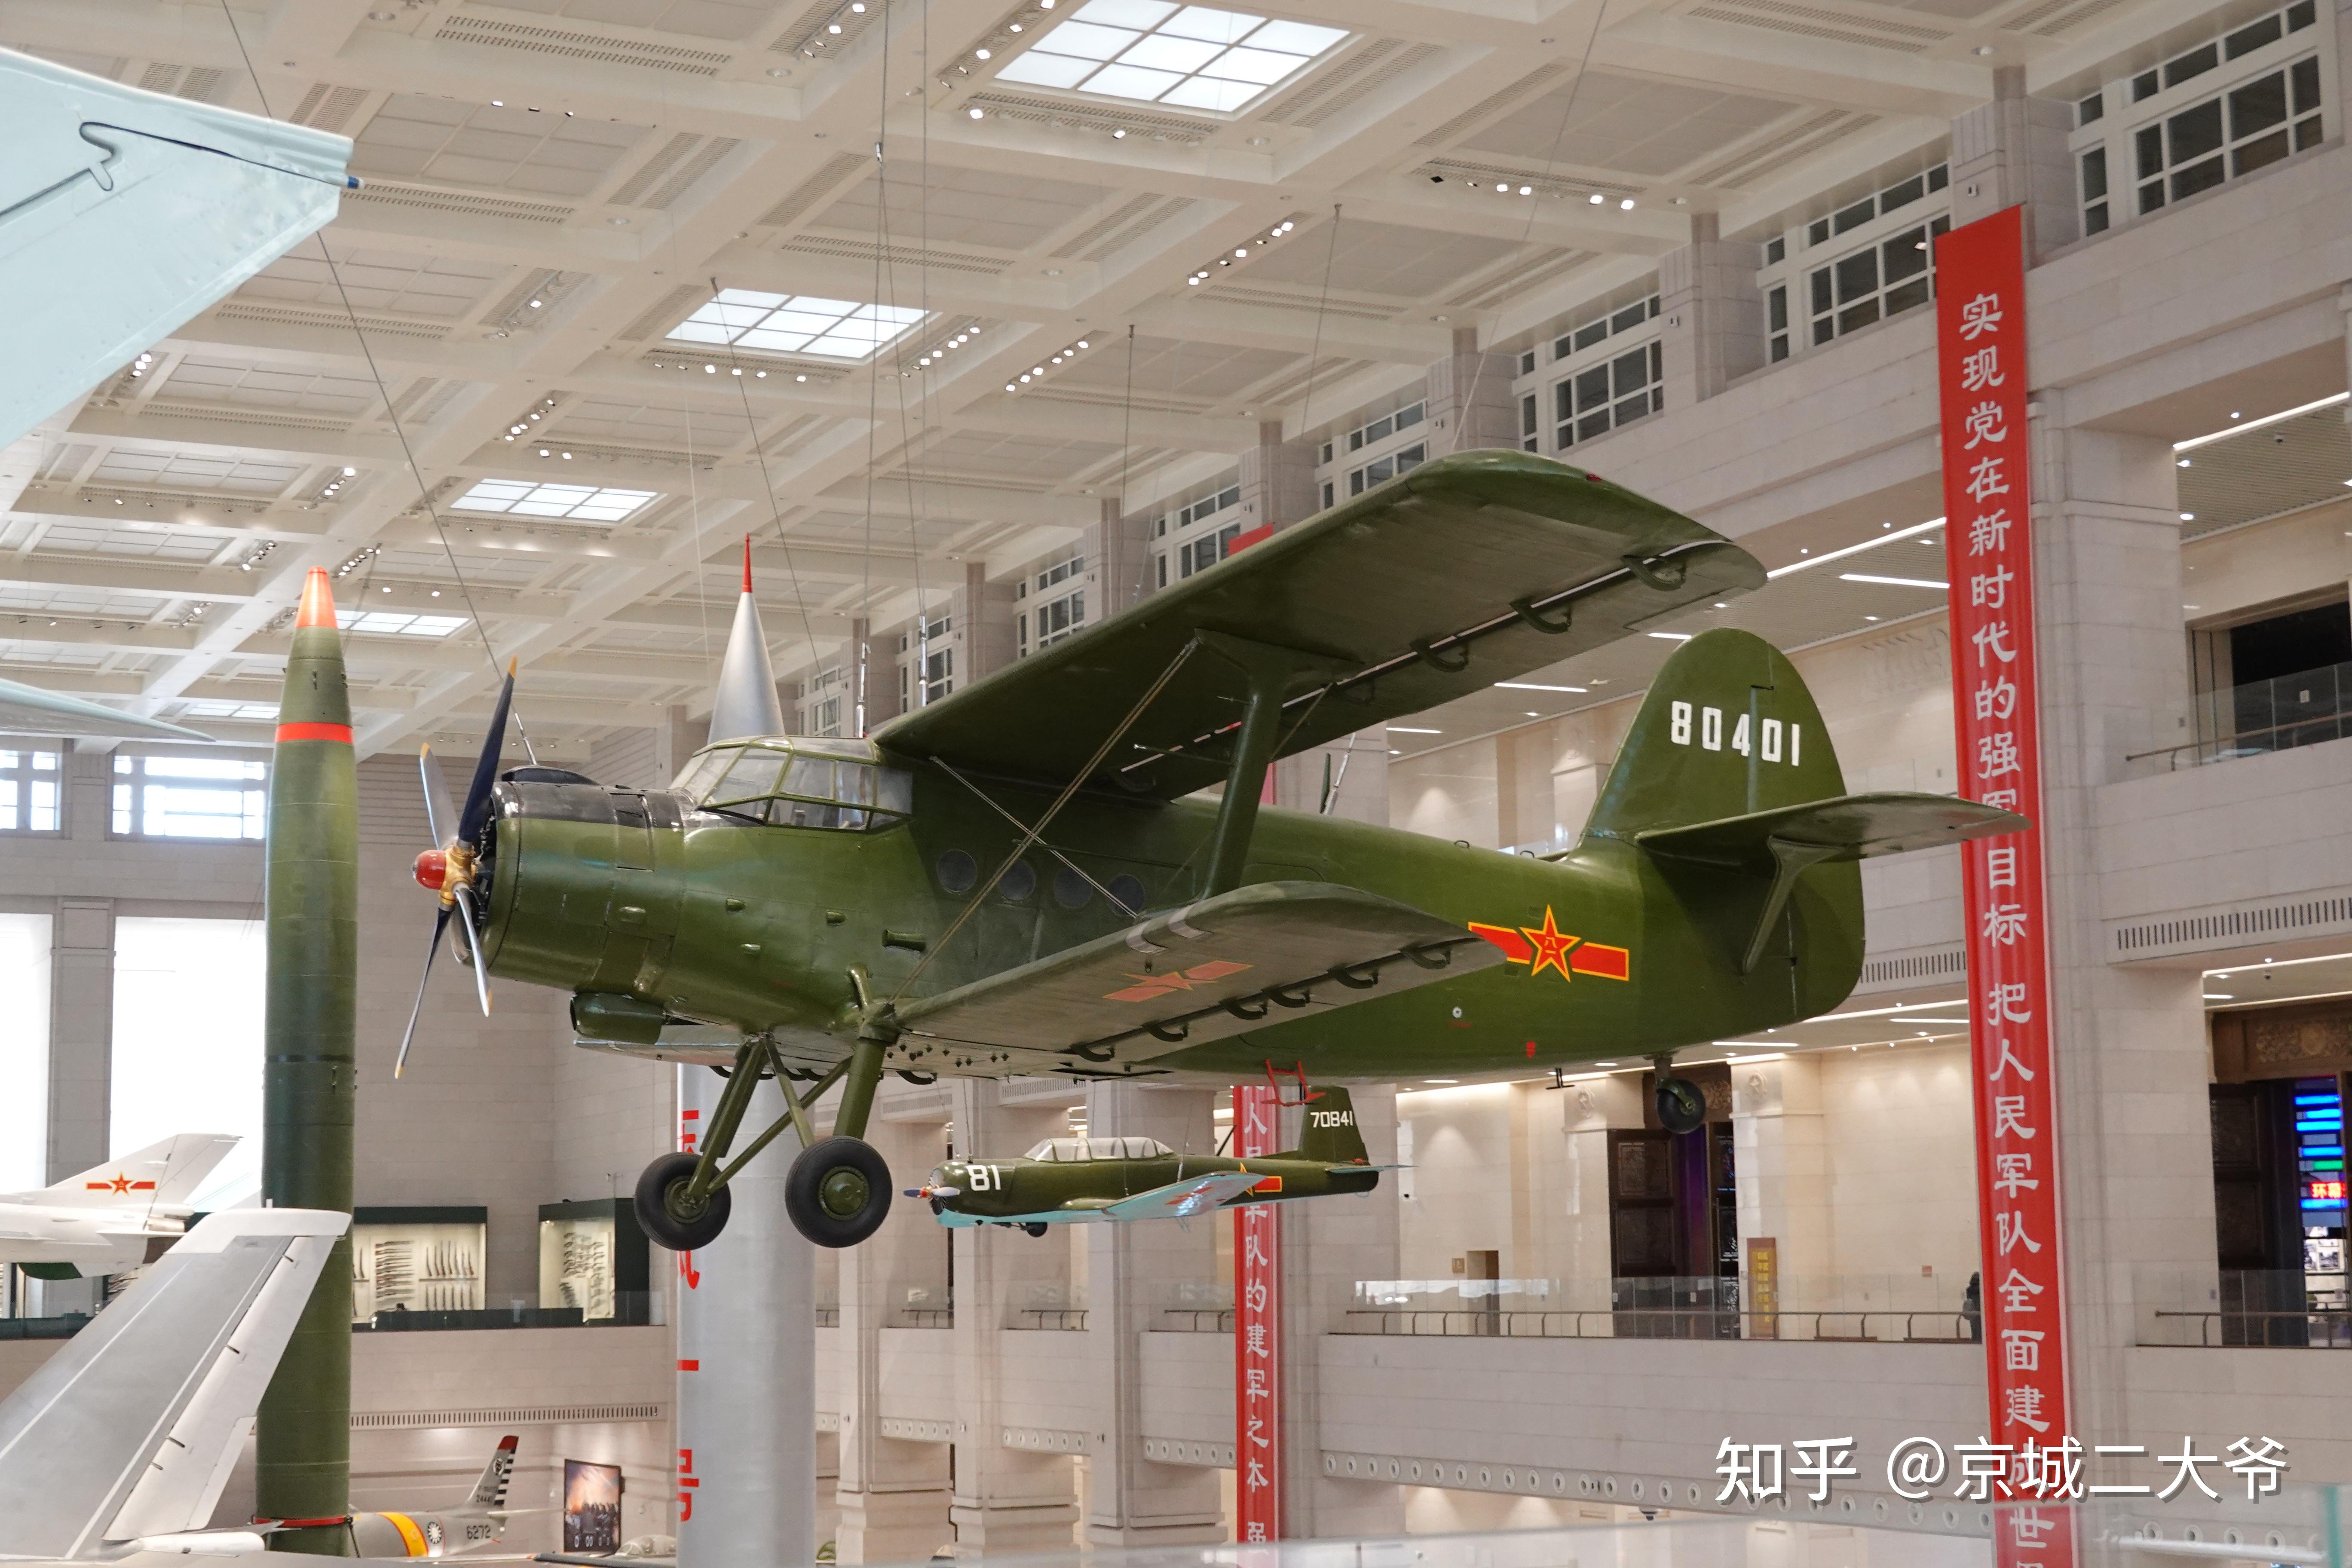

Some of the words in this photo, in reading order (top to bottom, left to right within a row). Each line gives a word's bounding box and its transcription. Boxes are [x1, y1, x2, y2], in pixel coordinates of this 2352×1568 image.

[1671, 701, 1800, 766] 80401
[1310, 1110, 1353, 1128] 70841
[965, 1164, 1001, 1191] 81
[1988, 982, 2055, 1568] 把人民军队全面建成世
[467, 1525, 490, 1540] 6272
